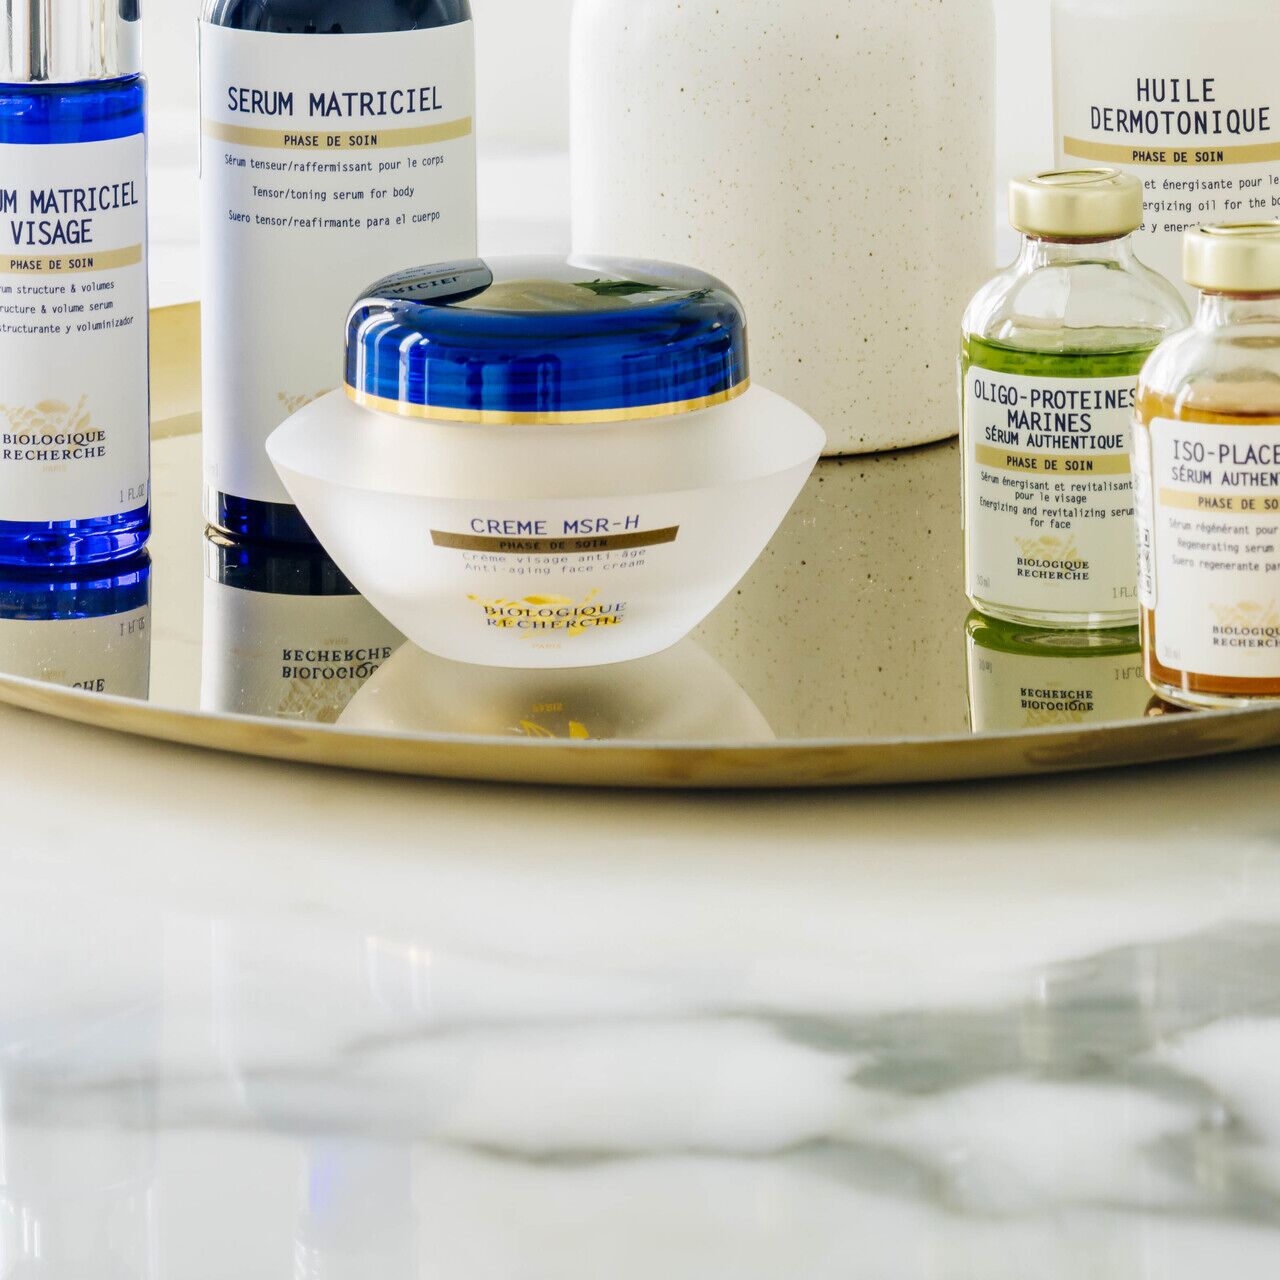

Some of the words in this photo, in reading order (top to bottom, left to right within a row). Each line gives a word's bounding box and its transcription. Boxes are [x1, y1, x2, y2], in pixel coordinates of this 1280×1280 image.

[1137, 78, 1215, 102] HUILE
[228, 86, 293, 116] SERUM
[309, 86, 442, 116] MATRICIEL
[1091, 106, 1270, 135] DERMOTONIQUE
[284, 135, 318, 146] PHASE
[327, 136, 341, 146] DE
[349, 135, 377, 146] SOIN
[225, 154, 246, 167] Sérum
[251, 159, 372, 172] tenseur/raffermissant
[379, 160, 401, 172] pour
[407, 157, 417, 168] le
[422, 155, 444, 167] corps
[1132, 150, 1166, 162] PHASE
[1174, 151, 1187, 162] DE
[1195, 151, 1224, 162] SOIN
[1144, 179, 1156, 190] et
[1163, 178, 1232, 190] énergisante
[1239, 177, 1262, 190] pour
[1269, 174, 1279, 184] le
[30, 181, 138, 214] MATRICIEL
[253, 186, 326, 201] Tensor/toning
[333, 190, 364, 200] serum
[370, 188, 387, 199] for
[393, 186, 415, 199] body
[1143, 200, 1192, 212] ergizing
[1198, 200, 1216, 211] oil
[1224, 199, 1242, 210] for
[1249, 198, 1266, 208] the
[228, 210, 250, 223] Suero
[255, 214, 360, 228] tensor/reafirmante
[367, 217, 390, 228] para
[396, 214, 406, 225] el
[412, 211, 440, 223] cuerpo
[11, 219, 93, 245] VISAGE
[10, 260, 42, 269] PHASE
[49, 260, 61, 269] DE
[69, 258, 93, 268] SOIN
[17, 284, 65, 293] structure
[81, 281, 114, 292] volumes
[52, 304, 84, 313] volume
[89, 301, 113, 310] serum
[76, 316, 133, 332] voluminizador
[975, 380, 1135, 410] OLIGO-PROTEINES
[1008, 409, 1091, 432] MARINES
[3, 430, 106, 446] BIOLOGIQUE
[985, 425, 1019, 445] SÉRUM
[1027, 434, 1123, 449] AUTHENTIQUE
[3, 446, 106, 460] RECHERCHE
[1007, 456, 1037, 469] PHASE
[1045, 460, 1057, 470] DE
[1065, 460, 1093, 470] SOIN
[981, 472, 999, 484] Sérum
[1003, 477, 1049, 491] énergisant
[1055, 483, 1065, 491] et
[1071, 481, 1133, 491] revitalisant
[1172, 465, 1212, 484] SÉRUM
[1015, 491, 1034, 501] pour
[1041, 493, 1049, 501] le
[1055, 494, 1087, 504] visage
[1198, 497, 1232, 509] PHASE
[1241, 499, 1255, 510] DE
[980, 497, 1018, 514] Energizing
[1023, 507, 1037, 515] and
[1043, 507, 1105, 518] revitalizing
[471, 518, 547, 535] CREME
[564, 514, 640, 534] MSR-H
[1030, 519, 1044, 527] for
[1050, 520, 1071, 529] face
[500, 541, 540, 550] PHASE
[550, 542, 565, 550] DE
[575, 540, 608, 548] SOIN
[1017, 557, 1089, 571] BIOLOGIQUE
[1017, 569, 1089, 580] RECHERCHE
[484, 602, 627, 617] BIOLOGIQUE
[487, 615, 623, 629] RECHERCHE
